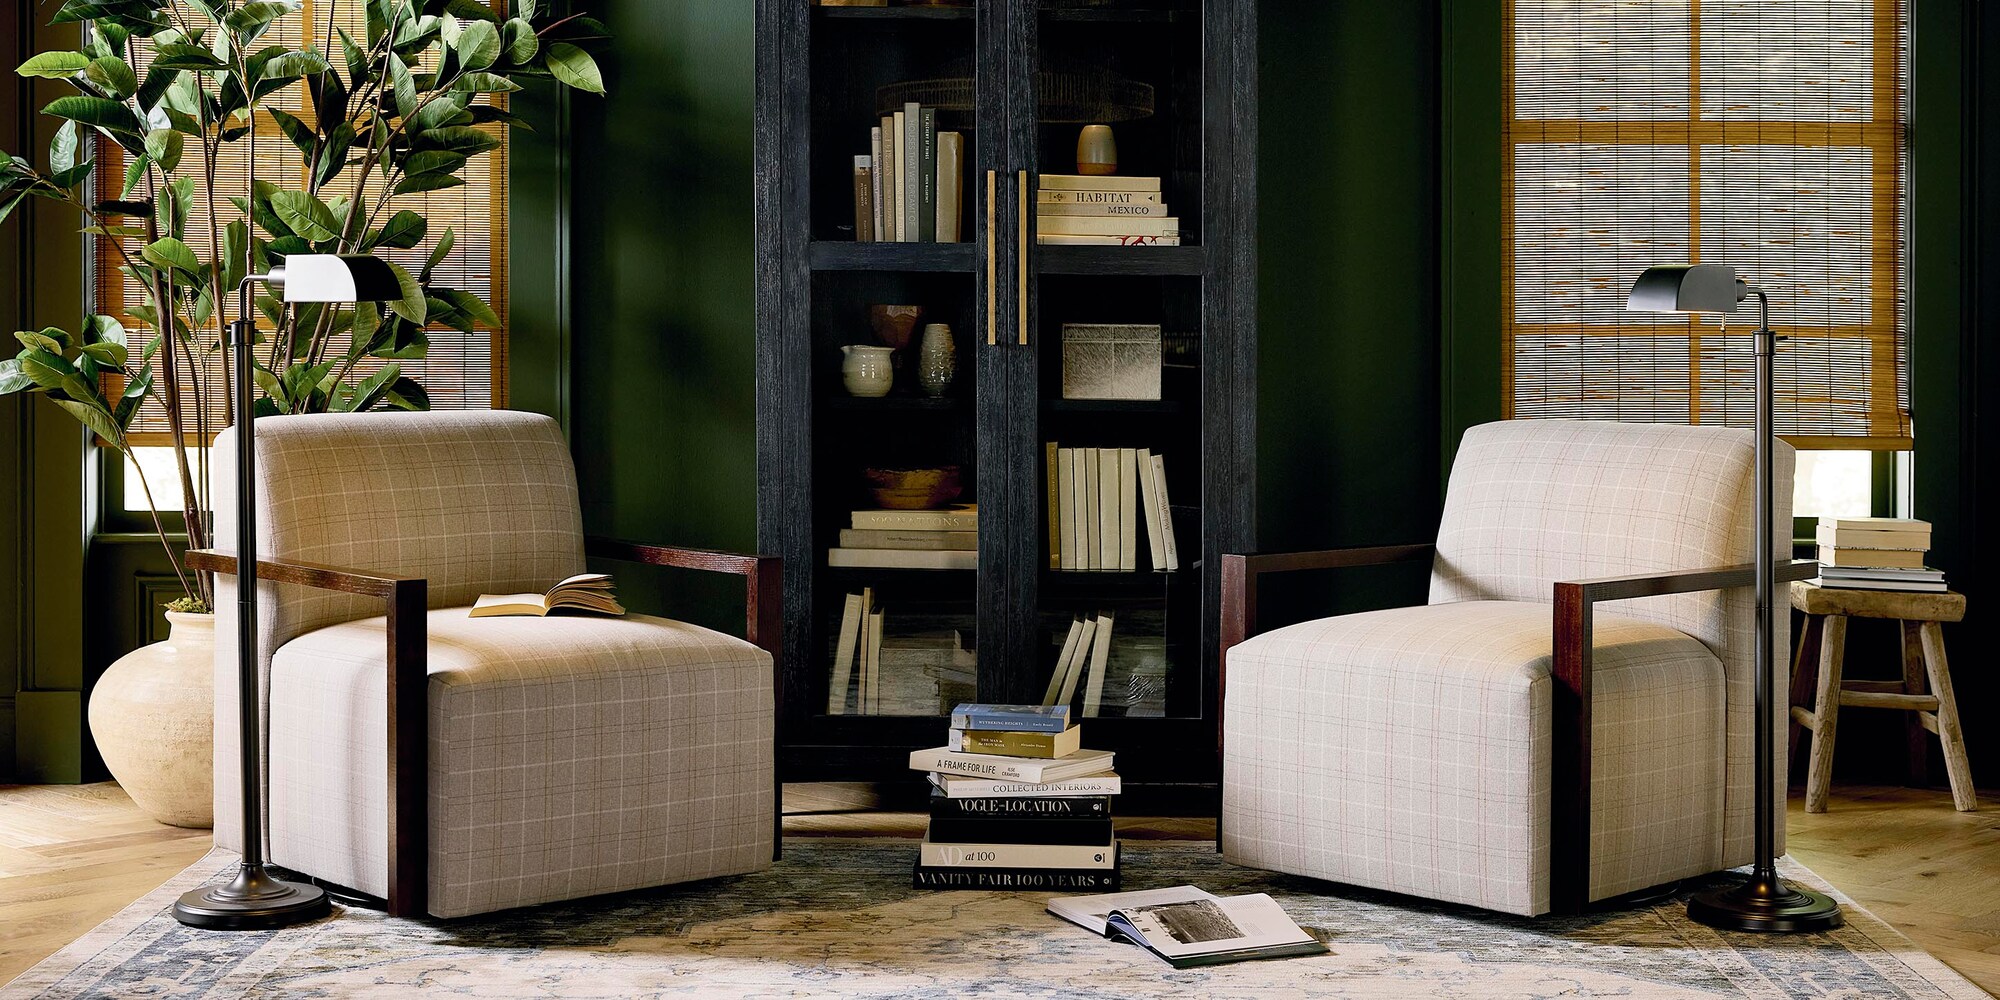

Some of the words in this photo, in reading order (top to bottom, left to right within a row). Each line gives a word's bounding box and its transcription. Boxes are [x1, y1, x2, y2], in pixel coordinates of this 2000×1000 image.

[908, 170, 915, 183] WE
[1076, 192, 1132, 203] HABITAT
[1108, 206, 1149, 214] MEXICO
[908, 216, 915, 226] OF
[896, 517, 960, 527] NATIONS
[937, 760, 942, 768] A
[944, 760, 967, 771] FRAME
[968, 762, 980, 773] FOR
[982, 764, 996, 775] LIFE
[993, 784, 1049, 792] COLLECTED
[1051, 783, 1102, 791] INTERIORS
[936, 846, 963, 865] AD
[965, 852, 974, 861] at
[977, 852, 996, 861] 100
[918, 873, 974, 884] VANITY
[979, 874, 1012, 886] FAIR
[1016, 875, 1043, 886] 100
[1046, 875, 1095, 886] YEARS
